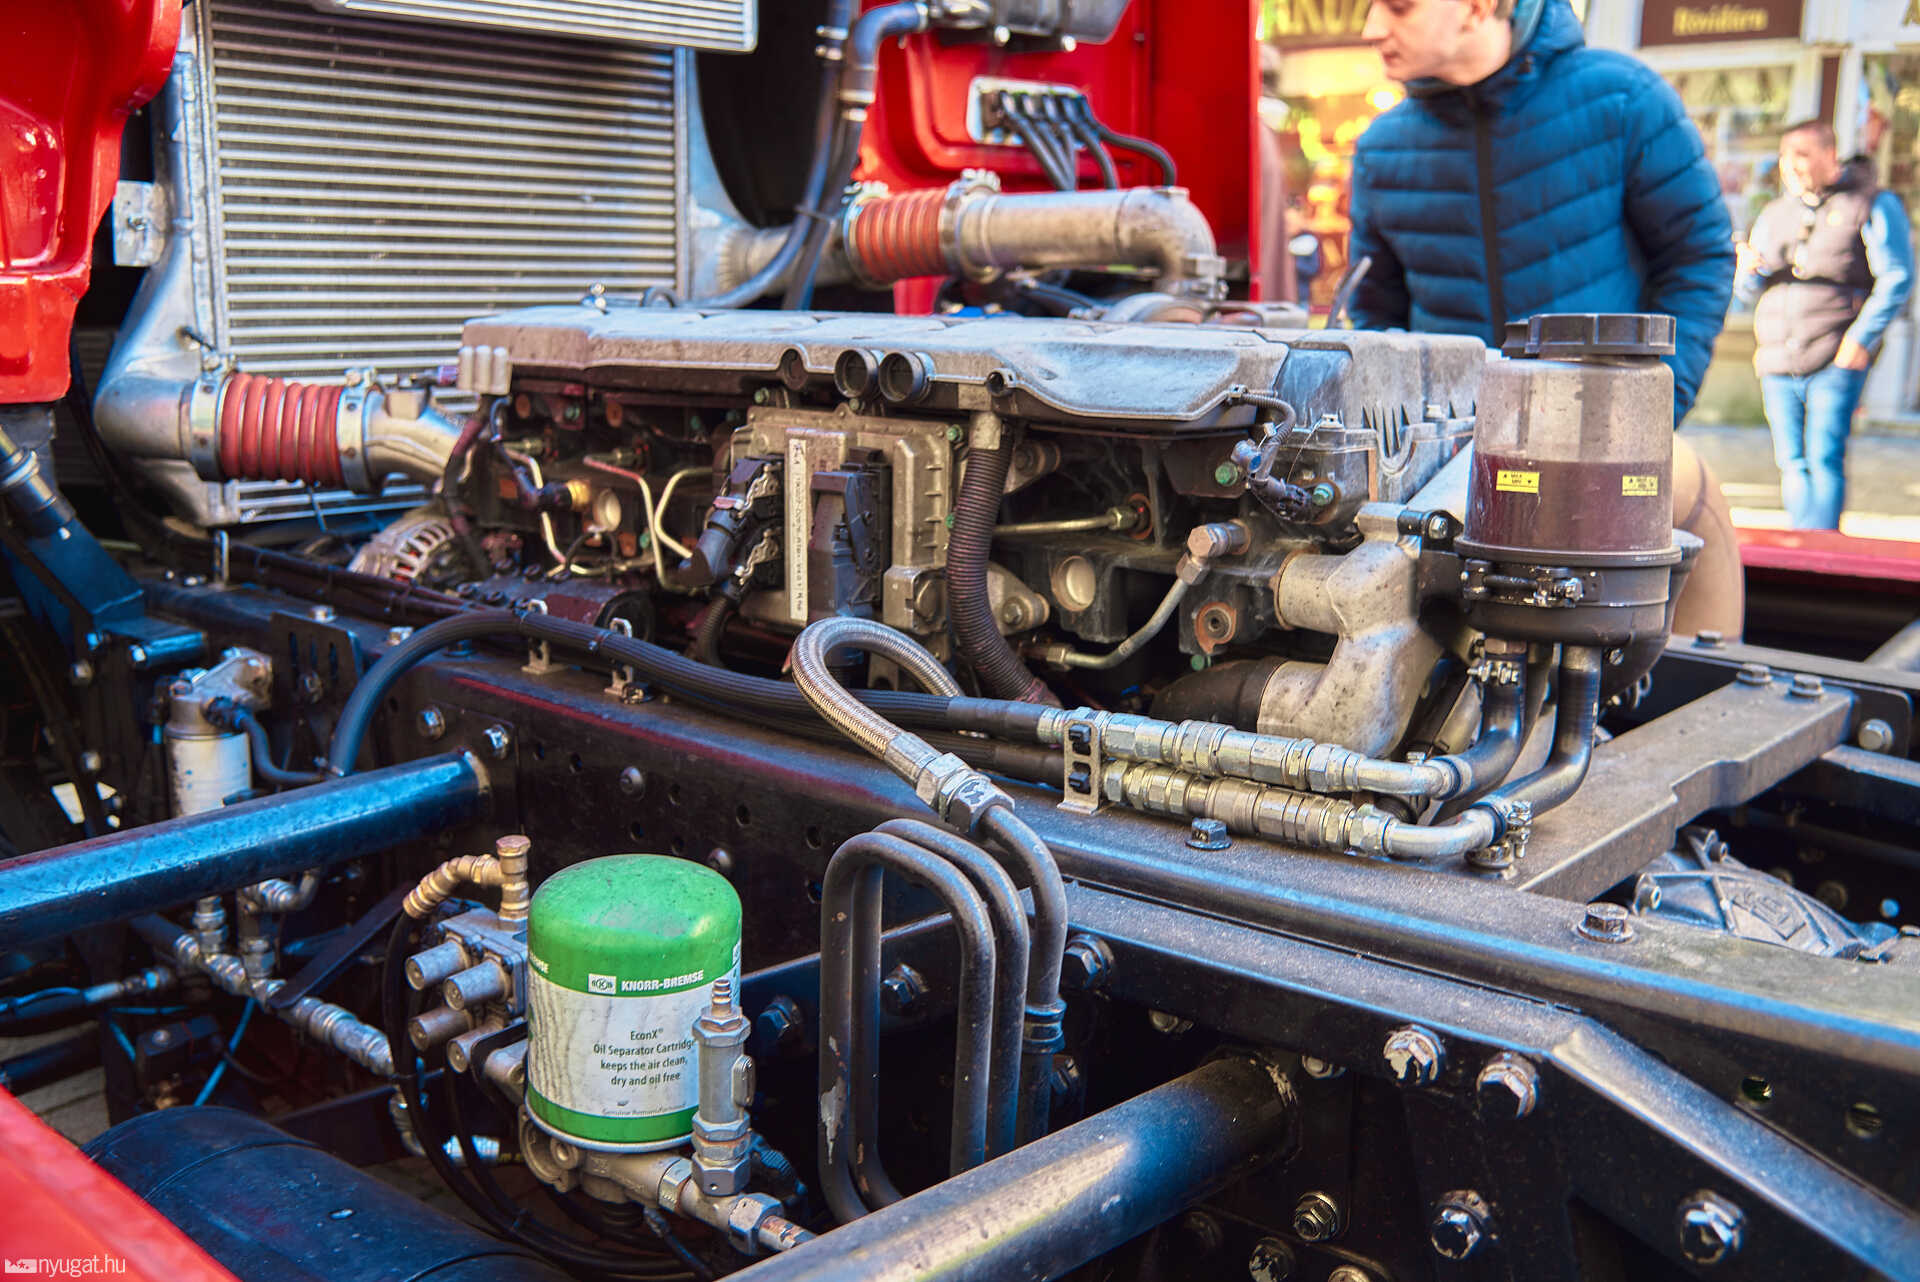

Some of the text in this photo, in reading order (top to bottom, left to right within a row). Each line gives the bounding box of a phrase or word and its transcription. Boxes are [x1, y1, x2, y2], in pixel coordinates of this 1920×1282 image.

[621, 970, 704, 992] KNORR-BREMSE
[593, 1044, 606, 1054] Oil
[608, 1044, 654, 1058] Separator
[600, 1056, 688, 1072] keeps the air clean,
[611, 1071, 681, 1088] dry and oil free
